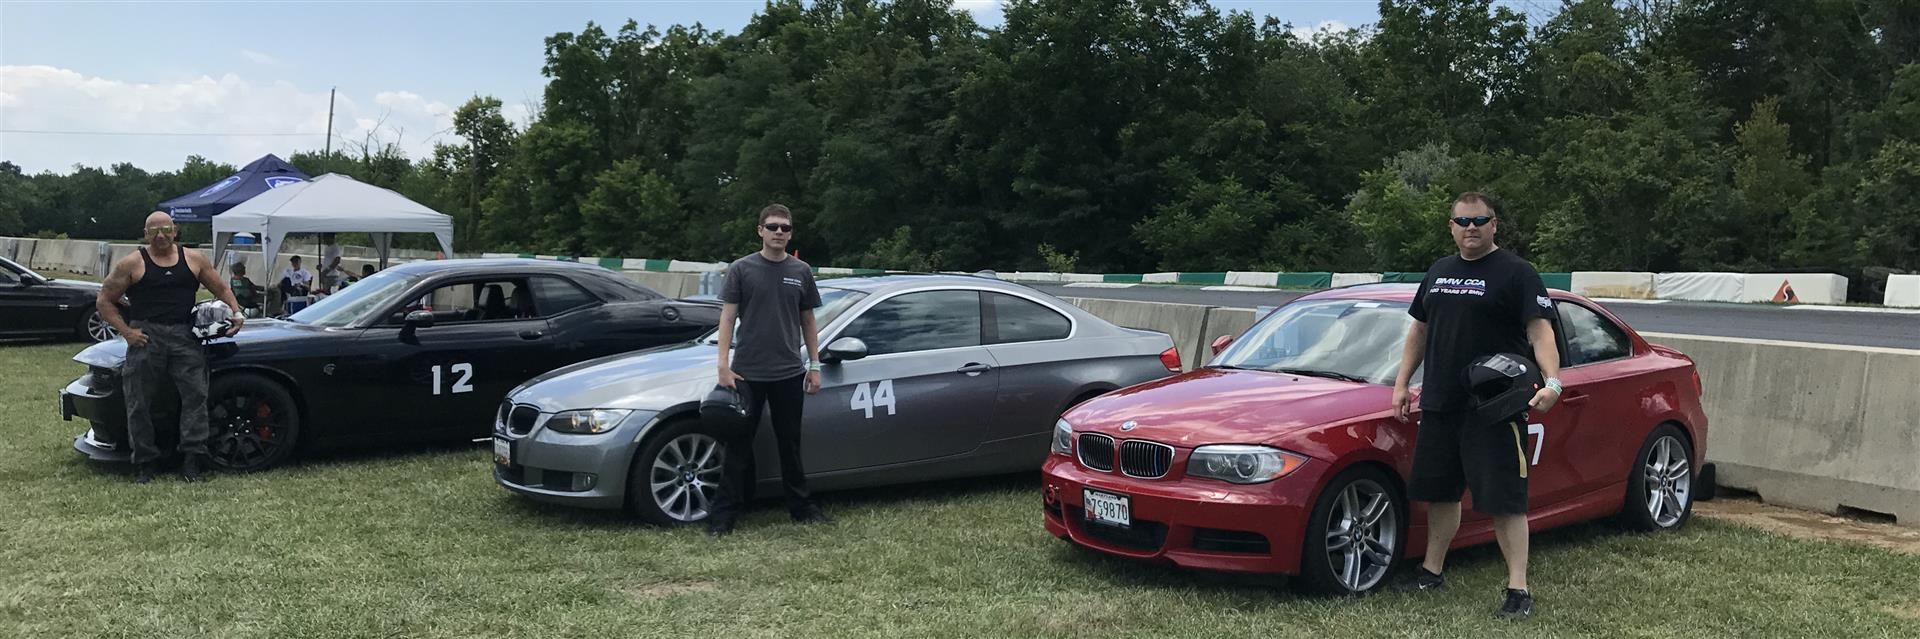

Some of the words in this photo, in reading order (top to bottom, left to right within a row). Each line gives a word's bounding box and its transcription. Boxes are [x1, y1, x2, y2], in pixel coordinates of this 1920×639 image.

[1464, 279, 1485, 287] CCA
[431, 362, 474, 395] 12
[850, 379, 896, 419] 44
